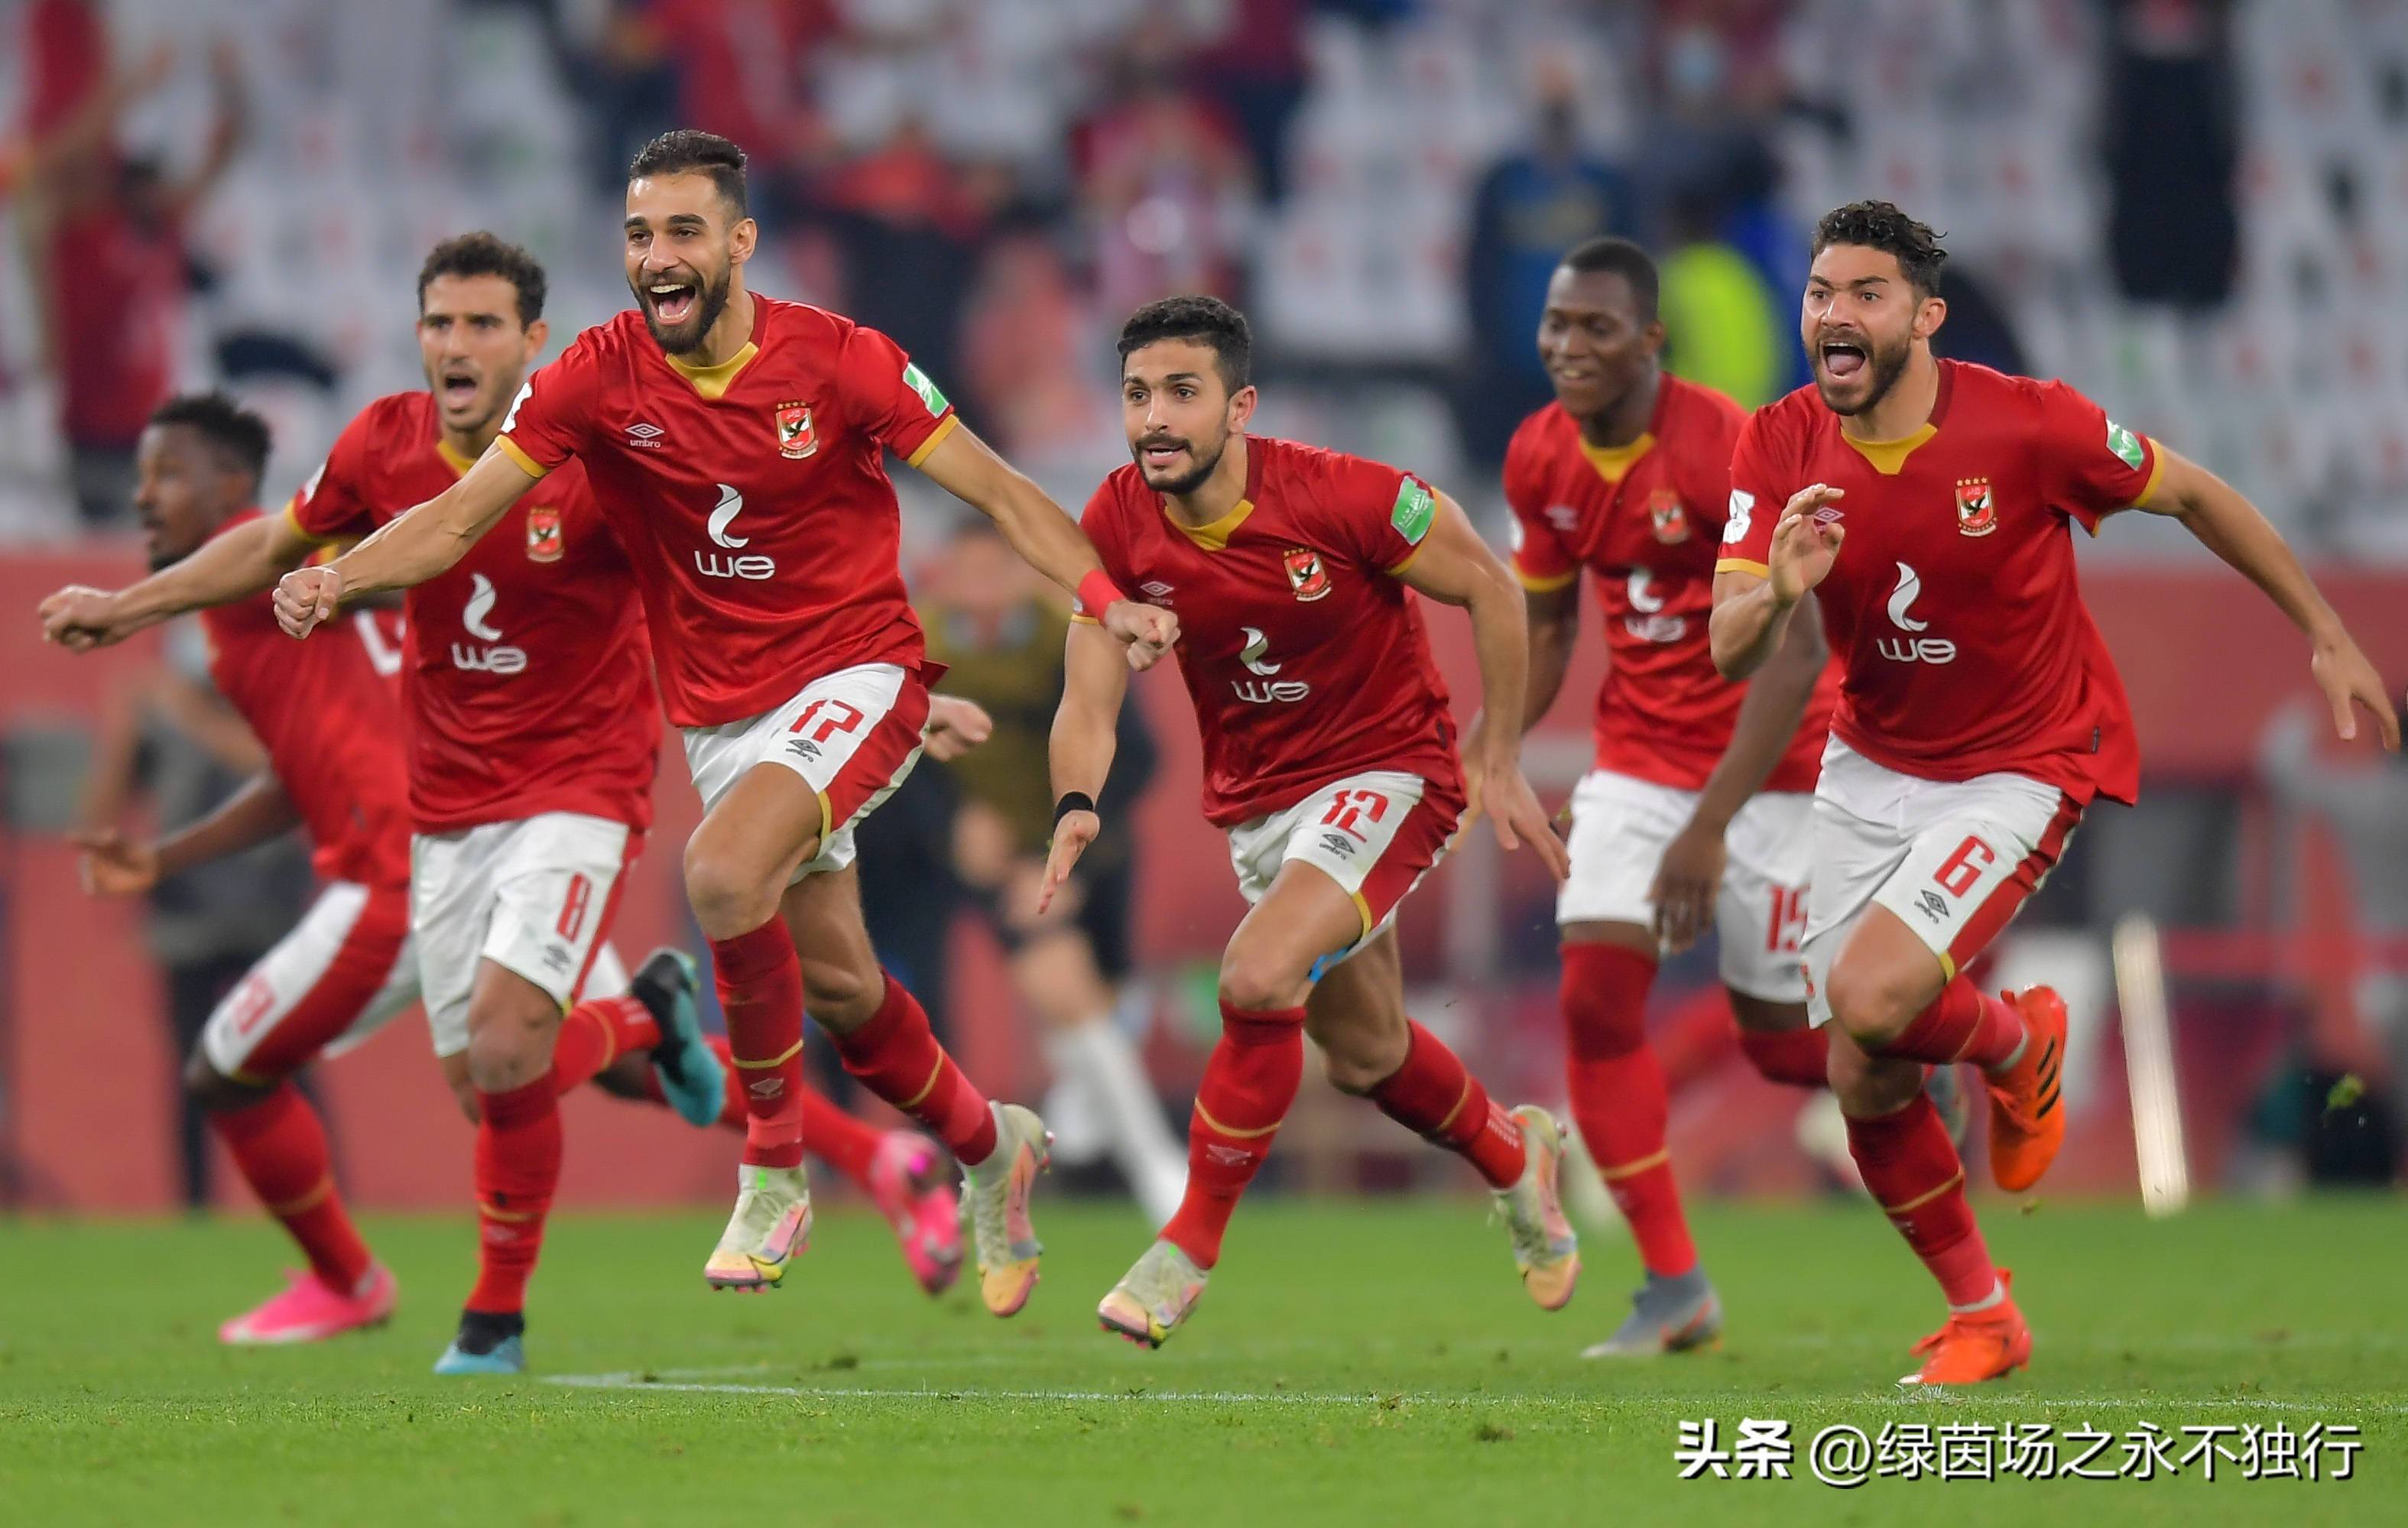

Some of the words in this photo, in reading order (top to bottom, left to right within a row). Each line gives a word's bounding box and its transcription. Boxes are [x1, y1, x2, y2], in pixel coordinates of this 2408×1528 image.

[630, 440, 660, 448] umbro
[694, 550, 775, 580] we
[1877, 637, 1957, 664] we
[788, 699, 865, 744] 17
[1320, 789, 1389, 844] 12
[1933, 835, 1995, 898] 6
